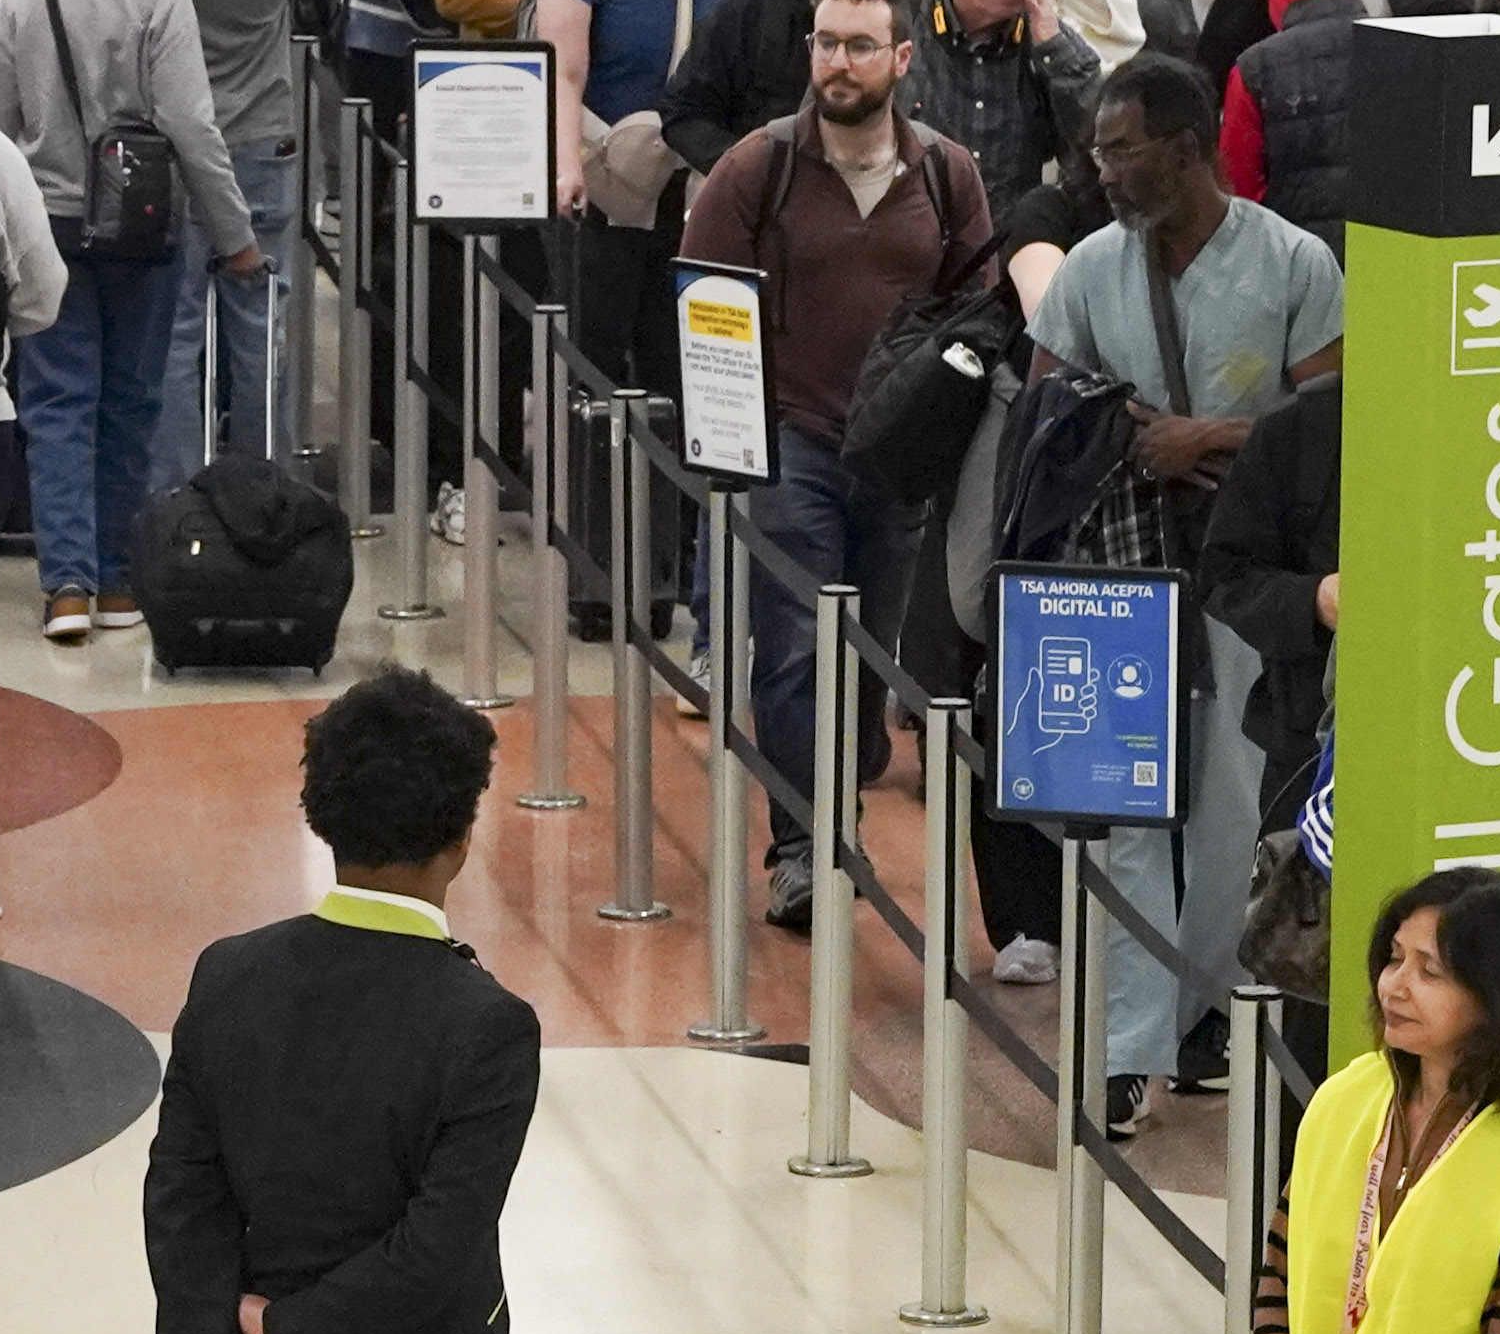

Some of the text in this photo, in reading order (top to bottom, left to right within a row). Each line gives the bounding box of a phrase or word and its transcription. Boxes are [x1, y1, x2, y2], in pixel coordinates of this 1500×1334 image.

[1020, 579, 1154, 598] TSA AHORA ACEPTA
[1039, 597, 1134, 618] DIGITAL ID.
[1053, 683, 1075, 703] ID
